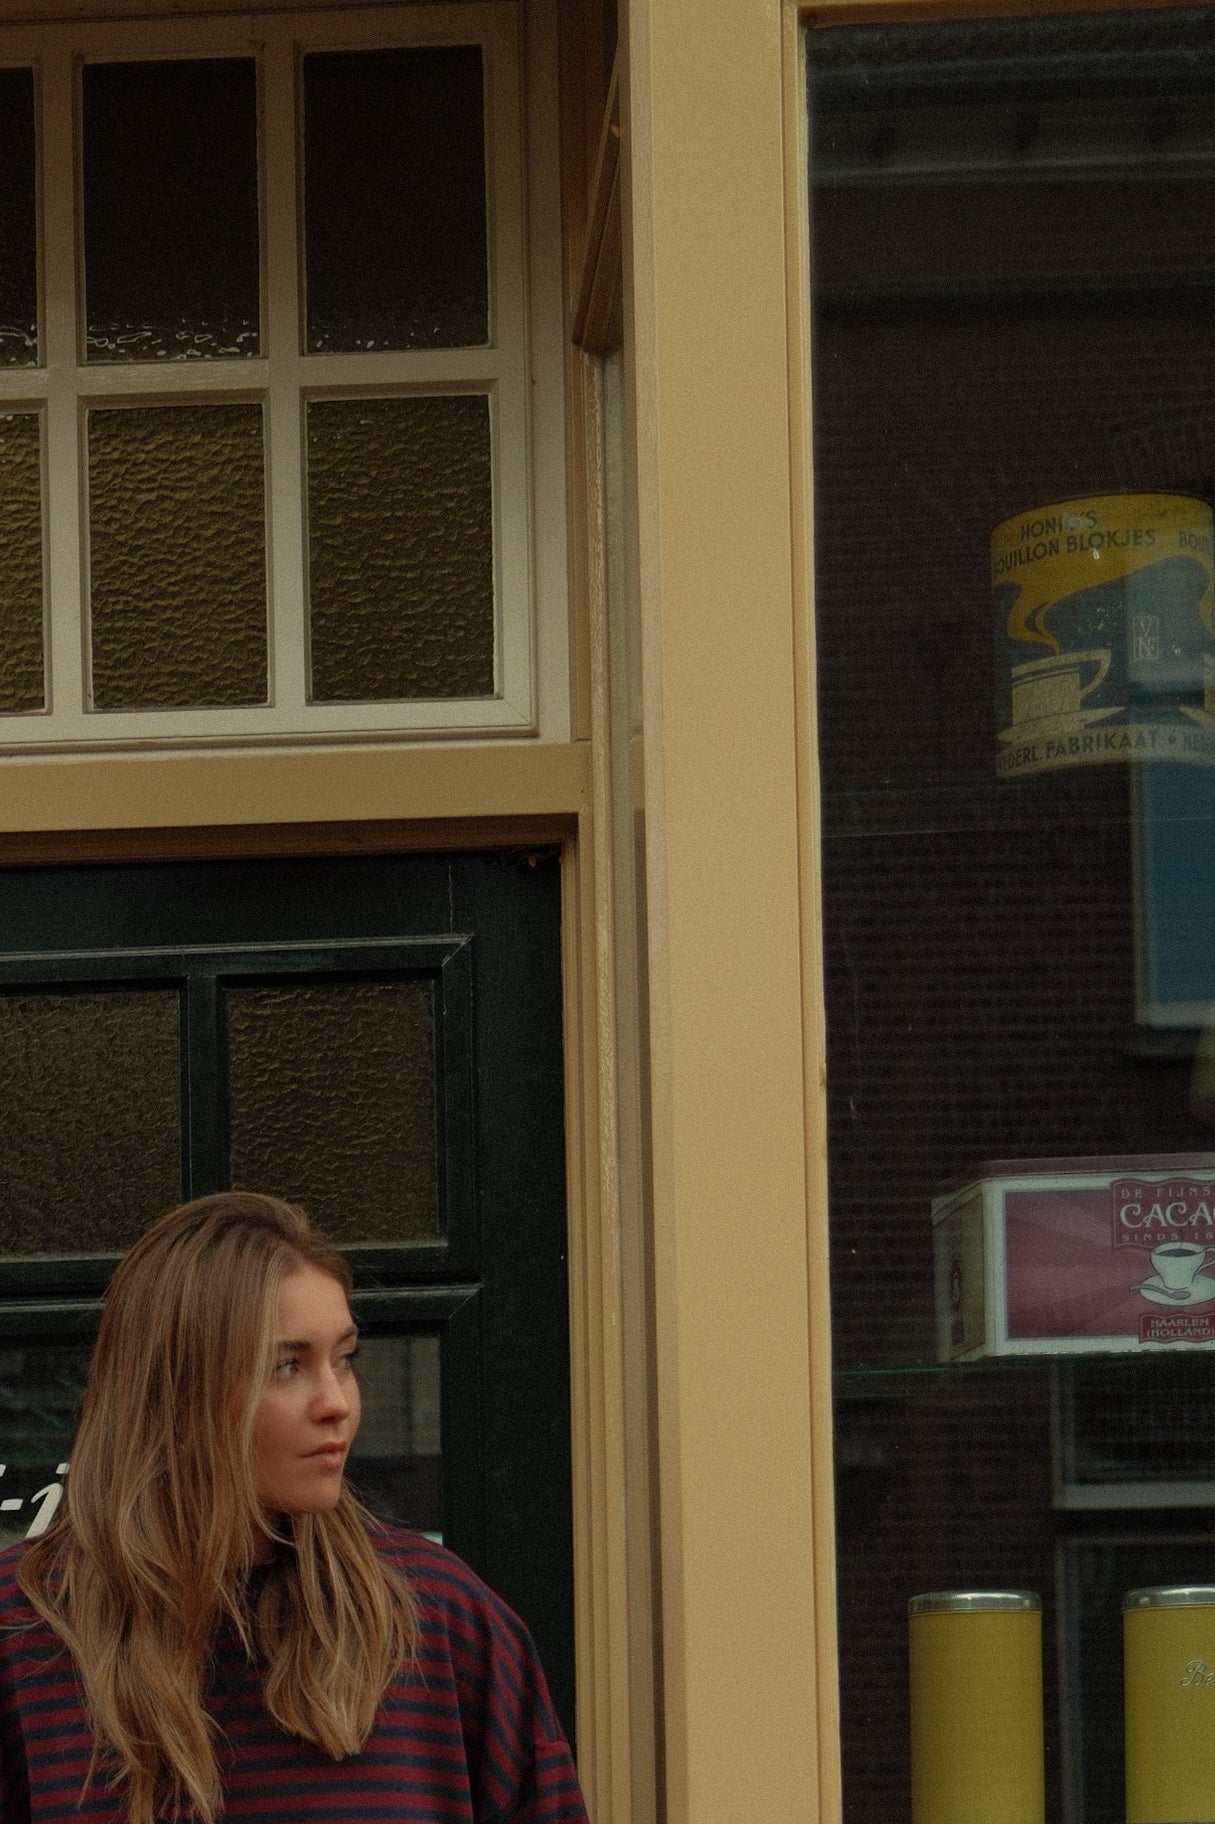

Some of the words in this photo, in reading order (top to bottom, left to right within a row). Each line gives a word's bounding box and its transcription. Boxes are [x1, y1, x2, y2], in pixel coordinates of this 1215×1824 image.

[1066, 529, 1157, 551] BLOKJES
[1046, 732, 1158, 759] FABRIKAAT
[1120, 1188, 1143, 1199] DE
[1119, 1201, 1215, 1229] CACA
[1150, 1318, 1210, 1328] HAARLEM
